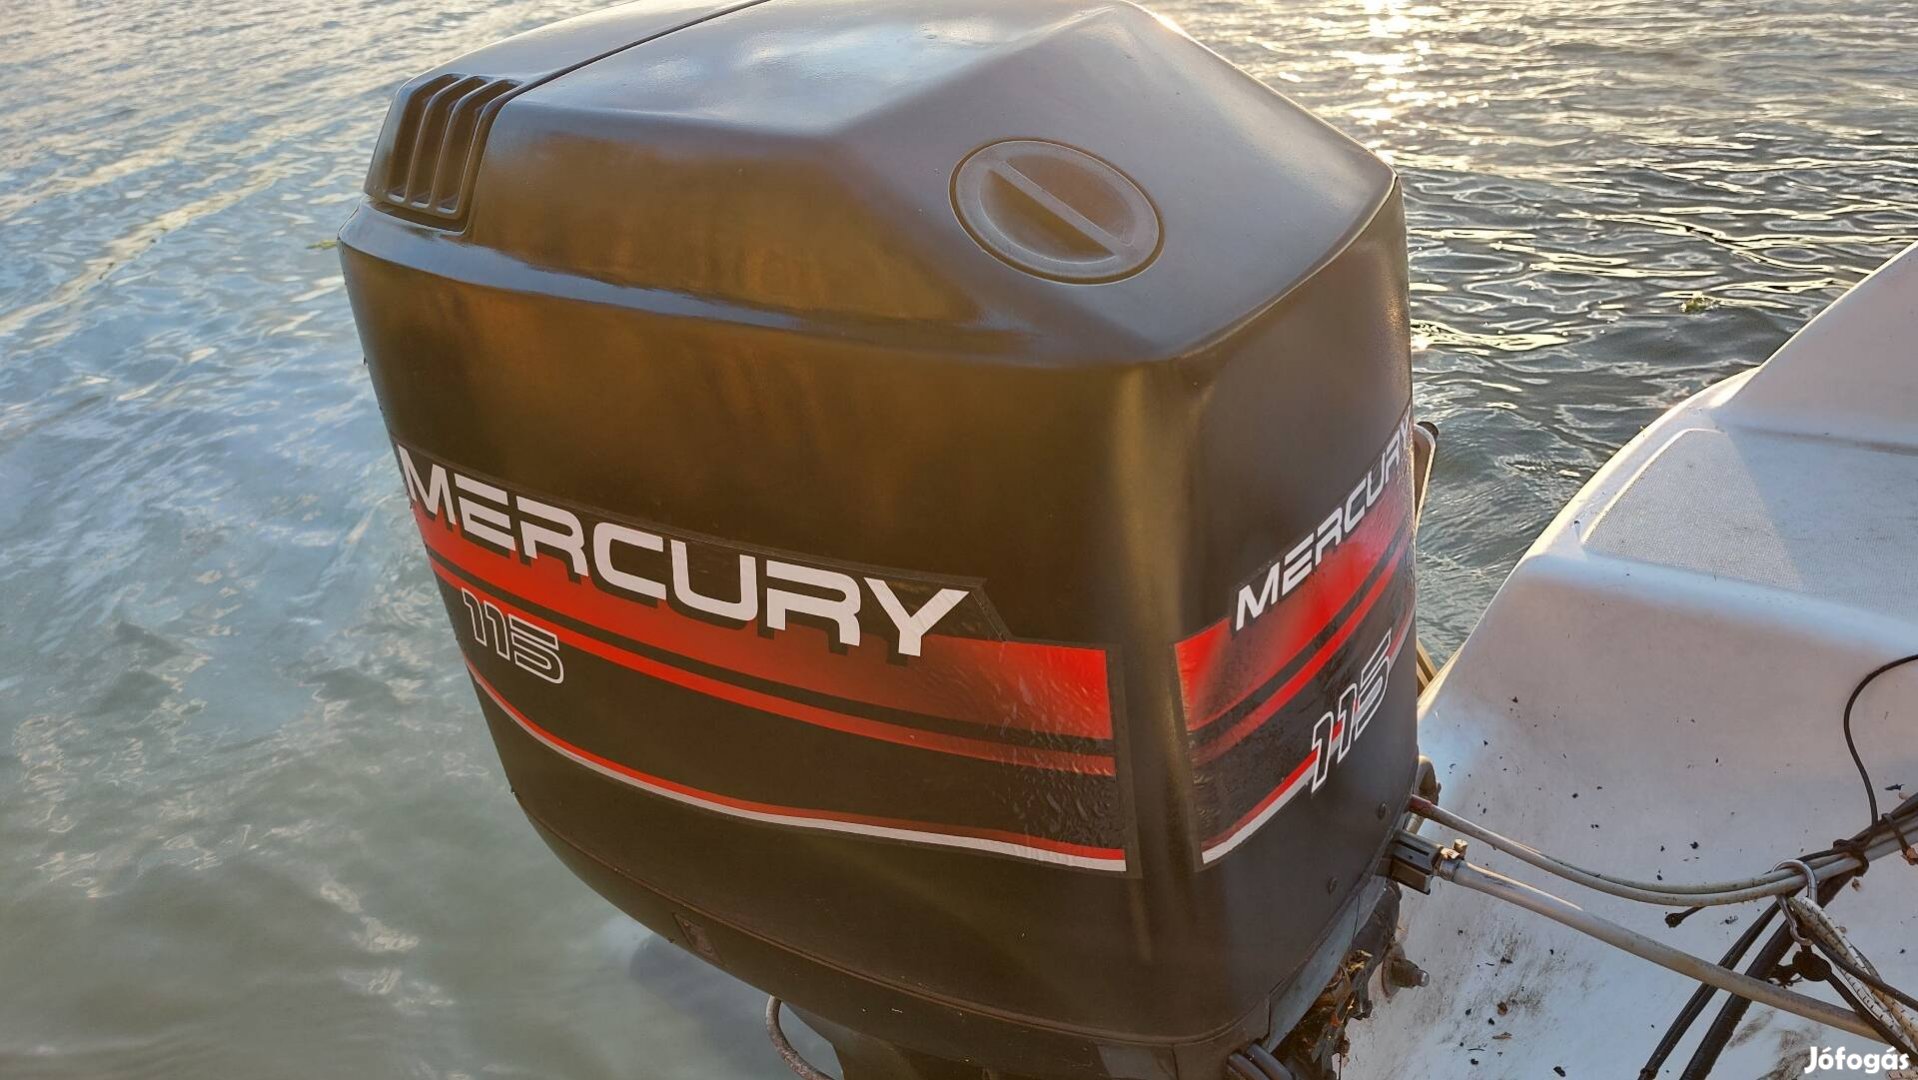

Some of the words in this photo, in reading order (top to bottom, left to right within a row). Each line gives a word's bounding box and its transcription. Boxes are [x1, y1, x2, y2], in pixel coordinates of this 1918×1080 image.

[397, 445, 970, 658] MERCURY
[1235, 404, 1412, 632] MERCURY
[462, 588, 565, 684] 115
[1311, 628, 1393, 793] 115
